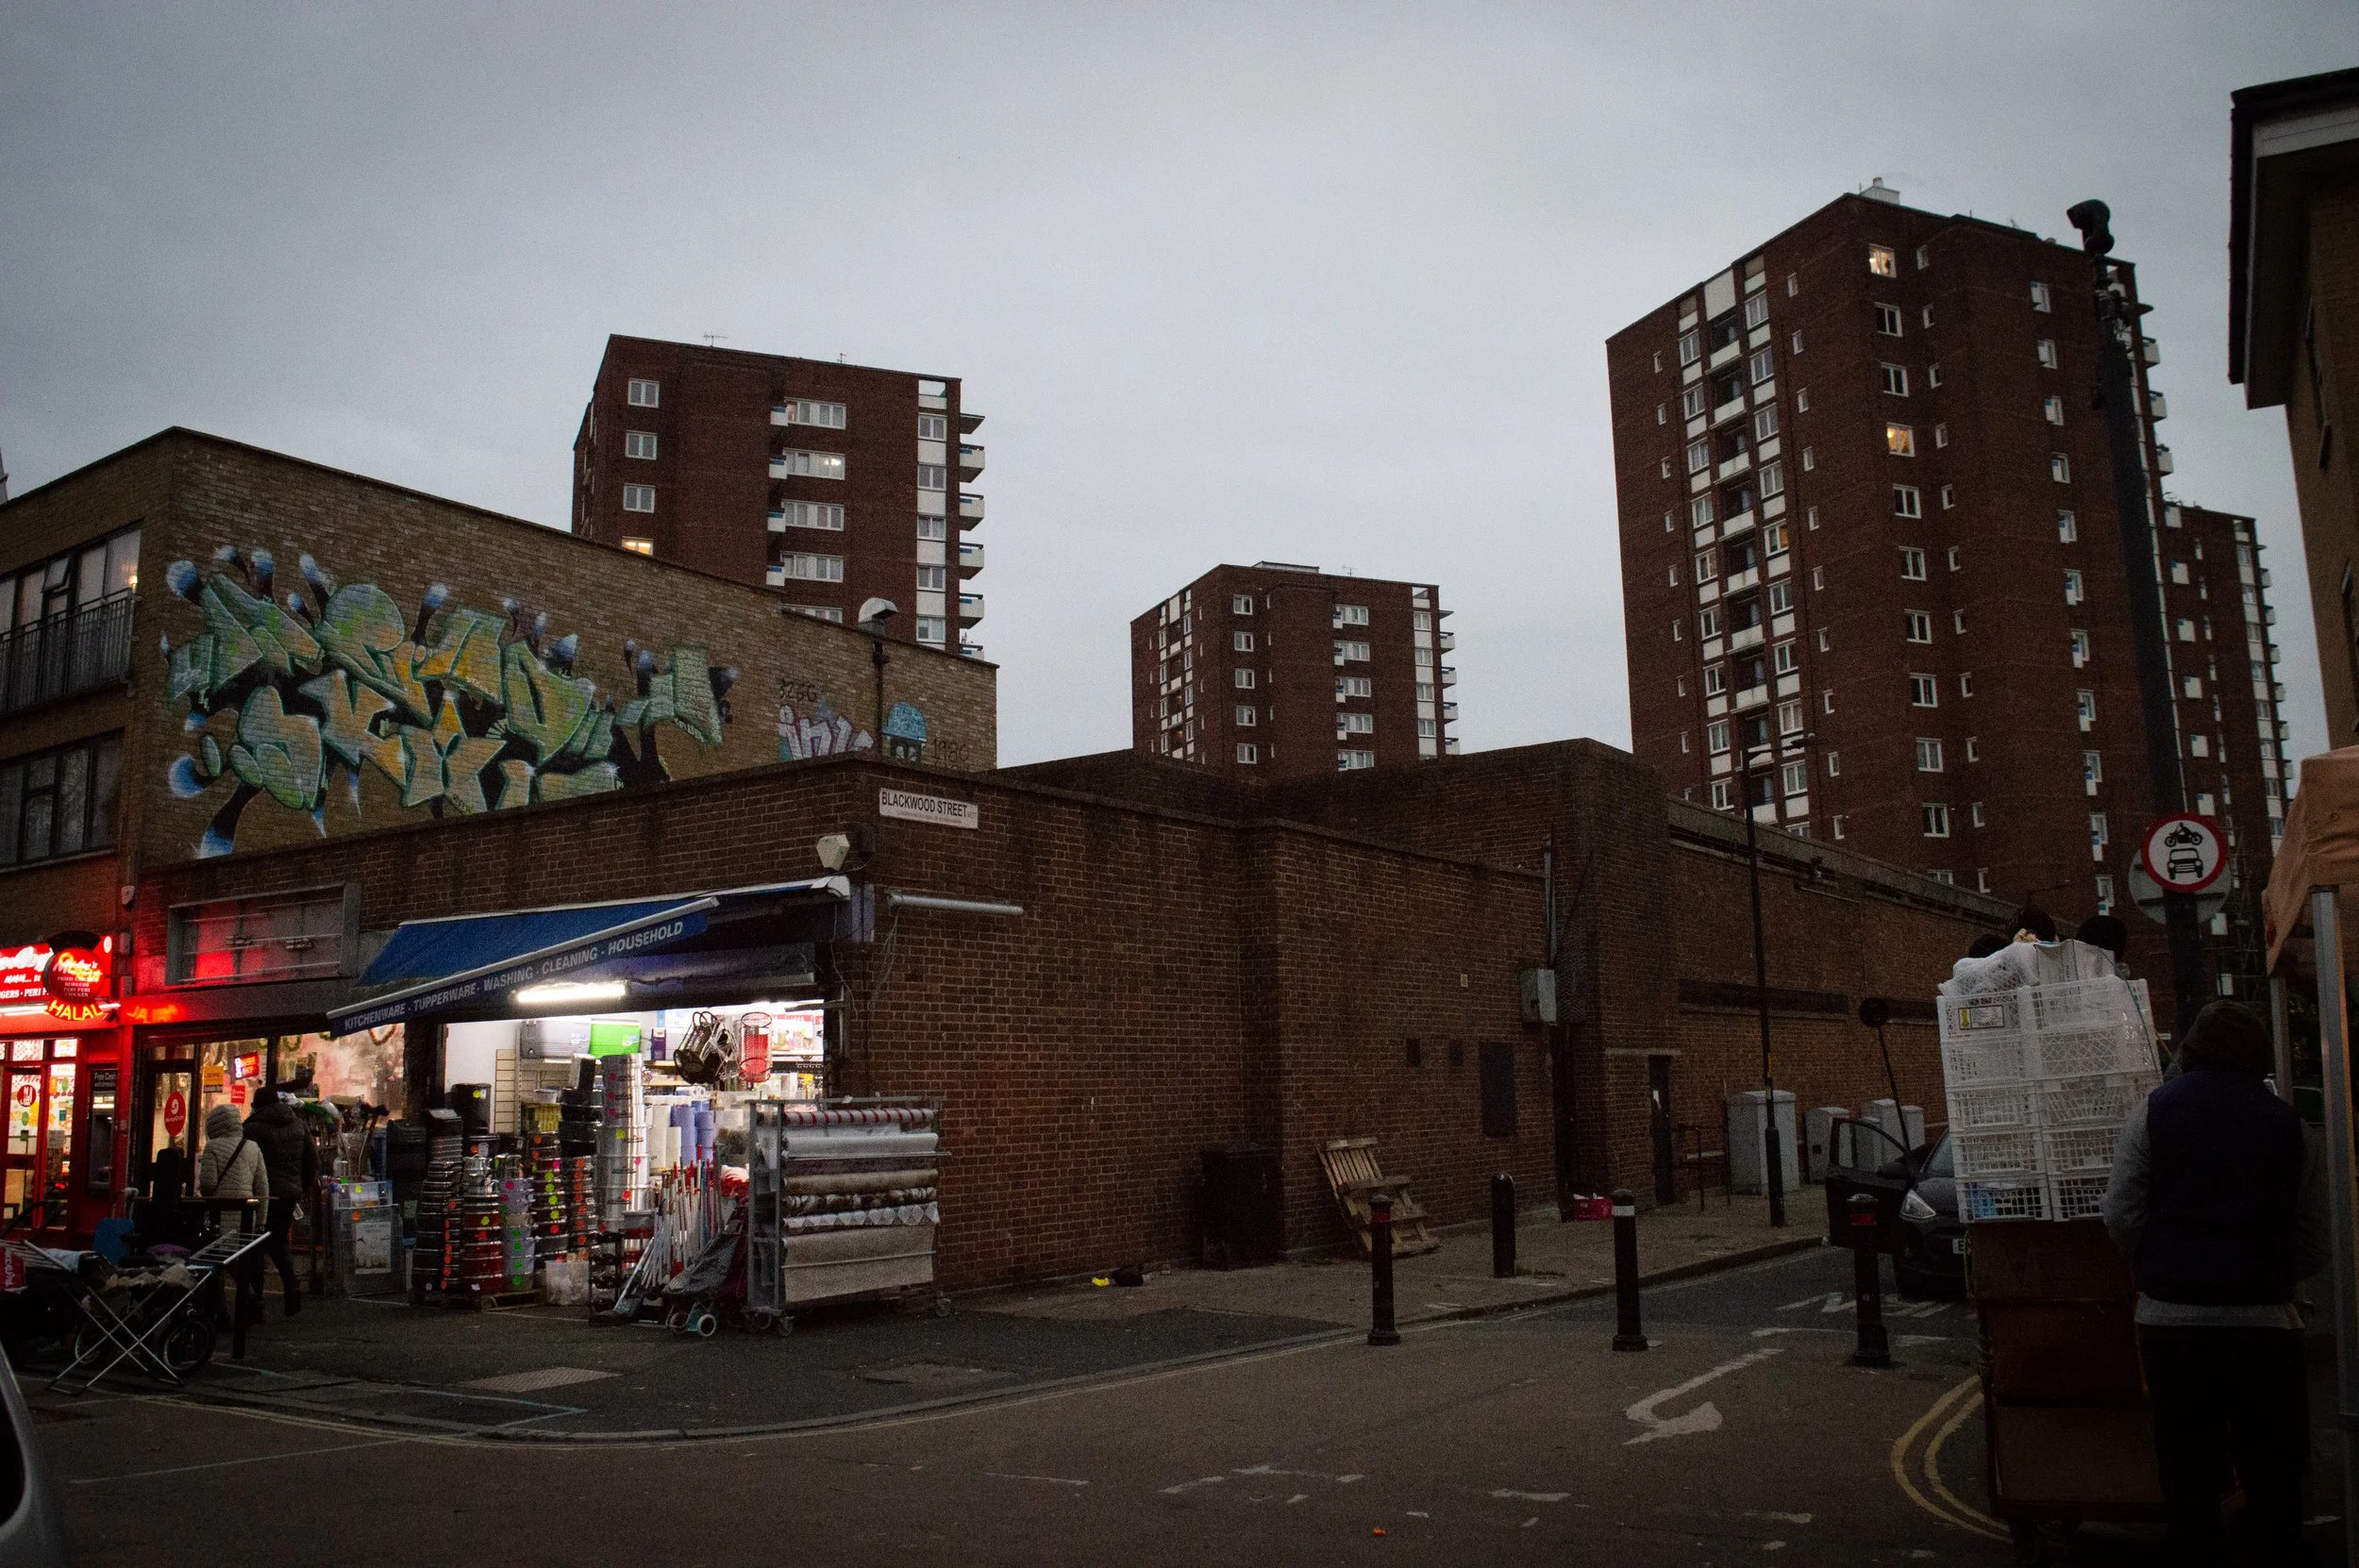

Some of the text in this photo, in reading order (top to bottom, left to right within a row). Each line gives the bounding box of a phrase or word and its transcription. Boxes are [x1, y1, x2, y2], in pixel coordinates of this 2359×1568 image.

[881, 792, 935, 813] BLACKWOOD
[937, 800, 968, 817] STREET
[344, 921, 684, 1030] KITCHENWARE TUPPERWARE WASHING CLEANING HOUSEHOLD
[0, 989, 20, 999] GERS
[24, 988, 42, 997] PERI
[48, 1000, 104, 1021] HALAL
